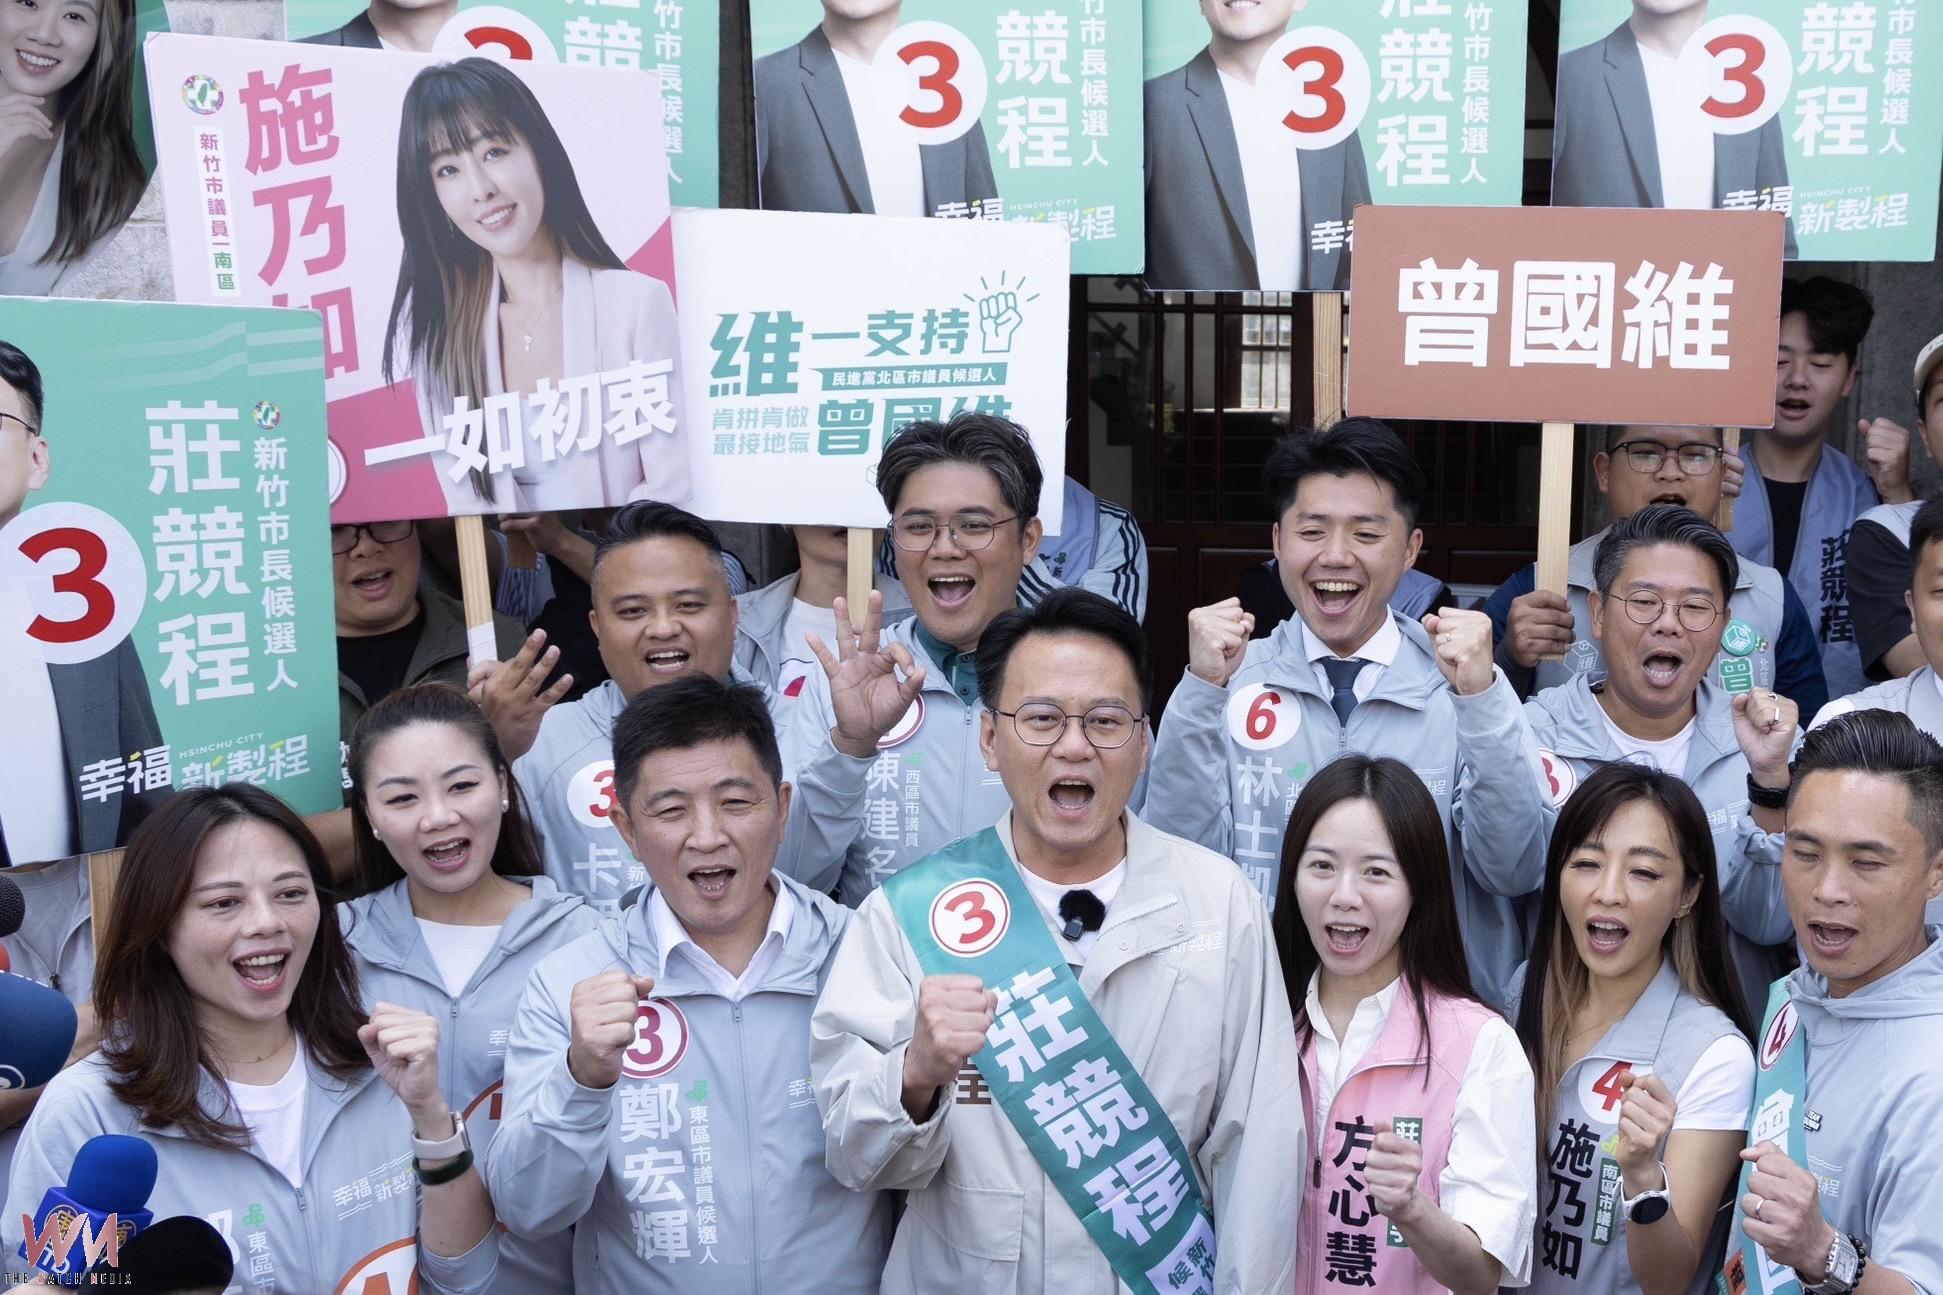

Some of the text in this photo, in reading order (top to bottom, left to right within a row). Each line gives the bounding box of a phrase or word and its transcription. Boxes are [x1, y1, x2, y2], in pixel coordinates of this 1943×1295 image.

[896, 41, 963, 129] 3
[995, 10, 1073, 169] 競程
[1281, 46, 1346, 134] 3
[1376, 0, 1454, 188] 競程
[1460, 3, 1493, 185] 竹市長候選人
[1700, 33, 1767, 119] 3
[1879, 0, 1917, 155] 市長候選人
[1009, 197, 1079, 212] HSINCHU CITY
[1311, 219, 1353, 255] 幸
[1797, 193, 1909, 236] 新製程
[1398, 257, 1734, 370] 曾國維
[364, 357, 678, 484] 一如初衷
[712, 405, 809, 430] 肯拼肯做
[831, 367, 997, 387] 民進黨北區市議員候選人
[712, 431, 810, 456] 最接地氣
[18, 527, 116, 644] 3
[145, 400, 255, 706] 莊競程
[253, 436, 299, 692] 新竹市長候選人
[179, 731, 265, 759] HSINCHU CITY
[1246, 691, 1282, 741] 6
[79, 744, 172, 803] 幸福
[904, 769, 921, 848] 西區市議員
[942, 890, 997, 944] 3
[625, 1005, 664, 1065] 3
[983, 966, 1190, 1247] 莊競程
[1592, 1061, 1633, 1112] 4
[619, 1083, 691, 1264] 鄭宏輝
[687, 1105, 719, 1265] 東區市議員候選人
[1325, 1114, 1378, 1288] 方心慧
[1542, 1118, 1601, 1281] 施乃如
